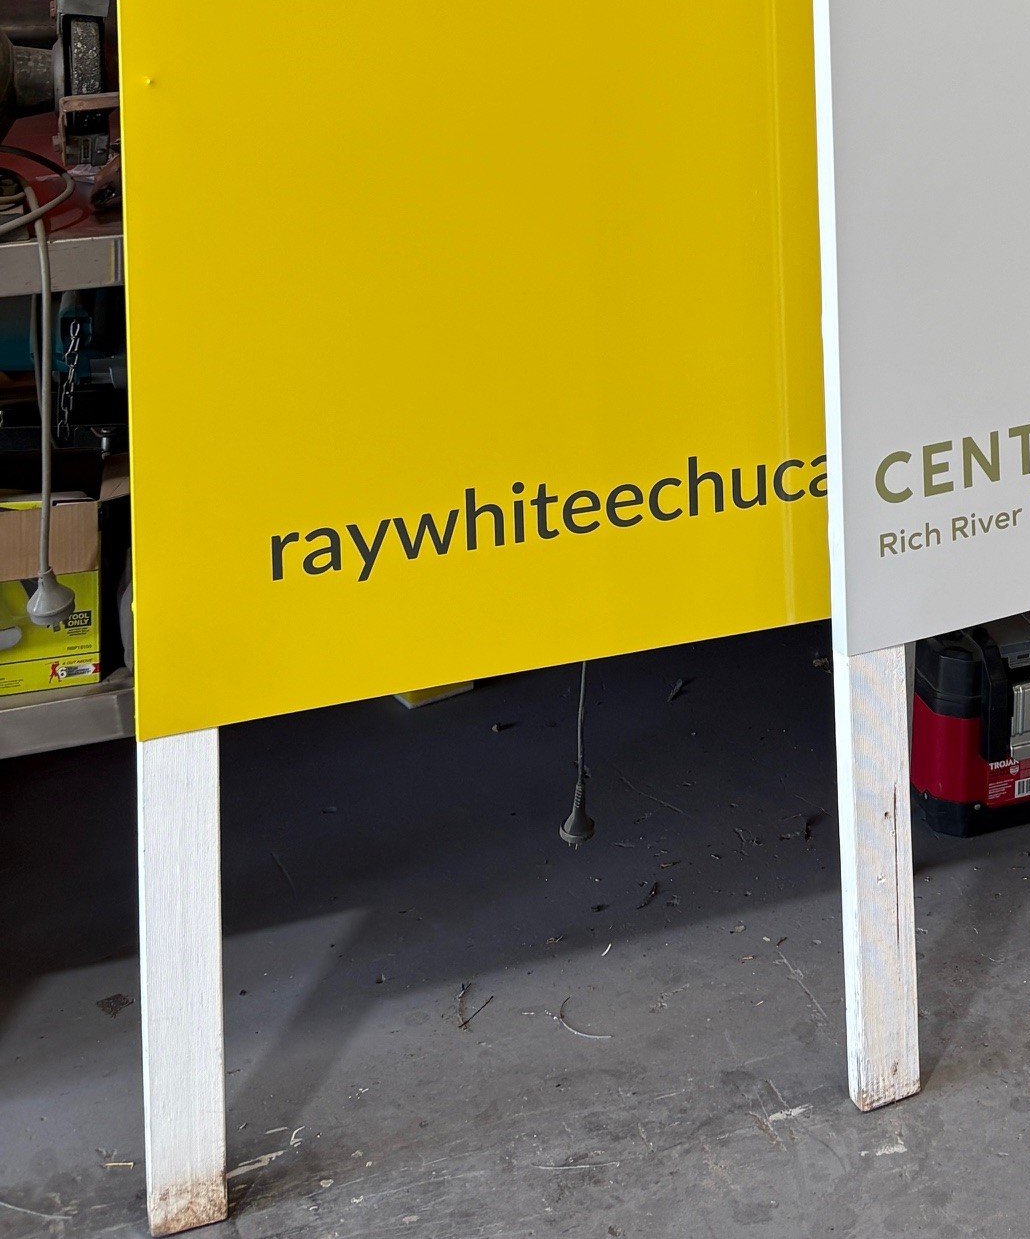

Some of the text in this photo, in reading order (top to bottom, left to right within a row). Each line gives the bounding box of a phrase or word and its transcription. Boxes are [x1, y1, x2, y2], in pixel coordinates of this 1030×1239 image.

[270, 454, 828, 583] raywhiteechuca
[878, 522, 942, 558] Rich
[951, 507, 1023, 542] River
[67, 618, 90, 627] ONLY
